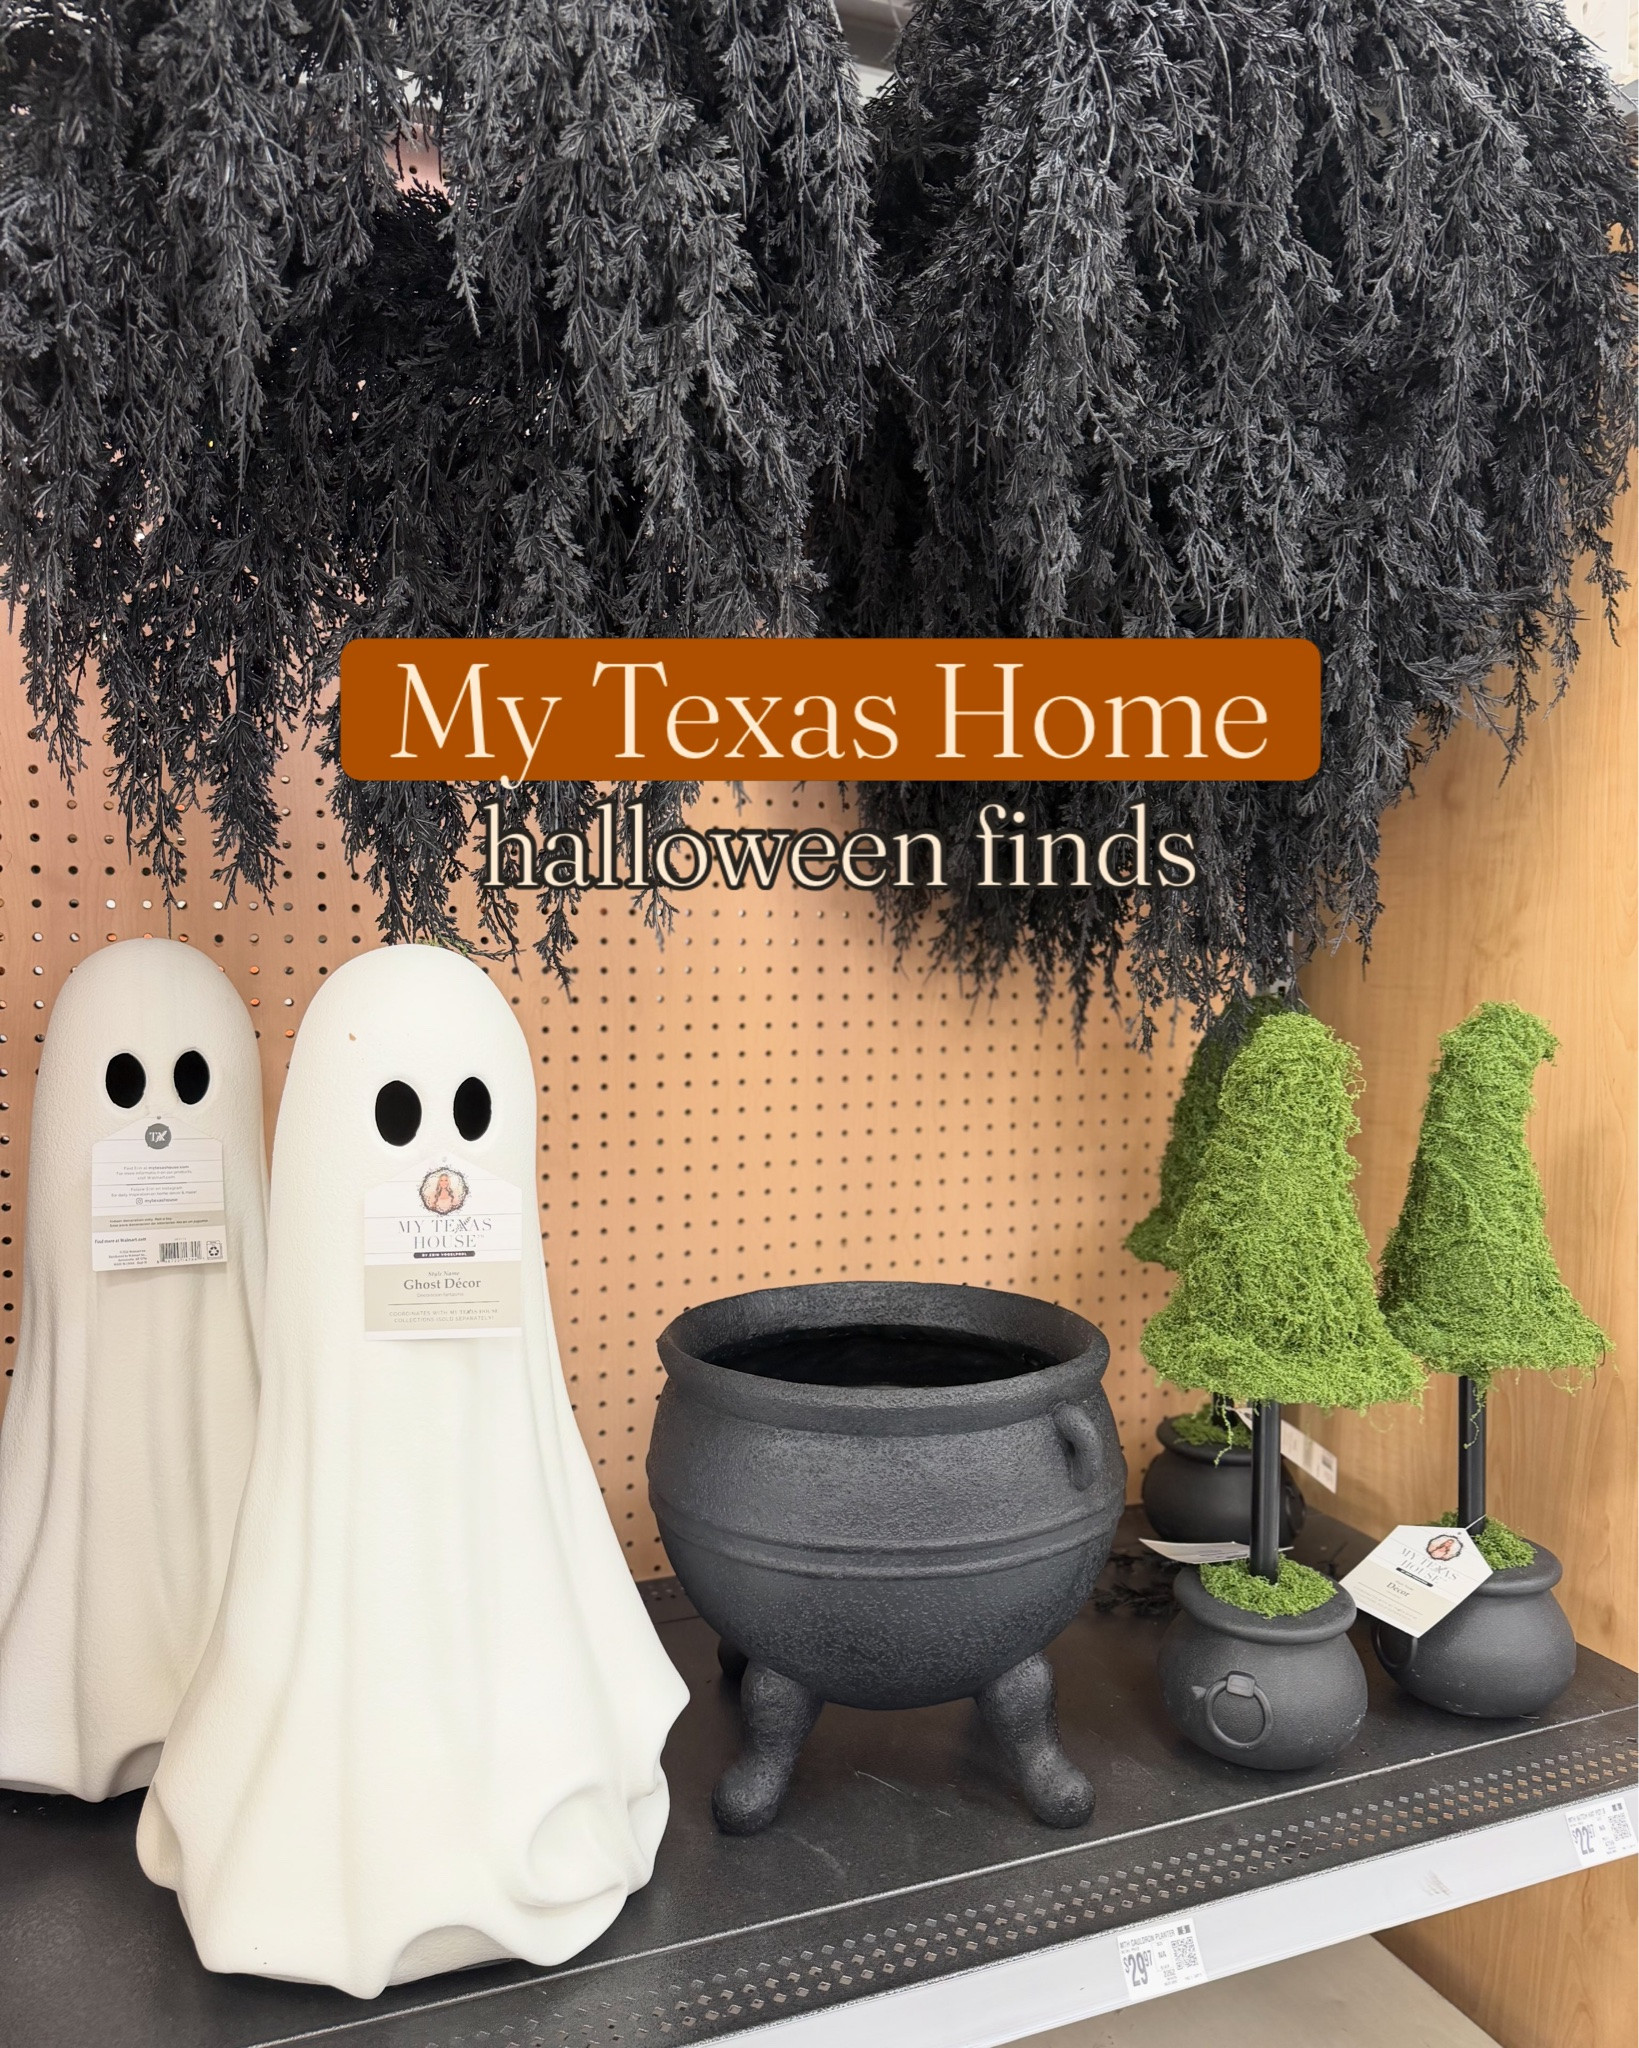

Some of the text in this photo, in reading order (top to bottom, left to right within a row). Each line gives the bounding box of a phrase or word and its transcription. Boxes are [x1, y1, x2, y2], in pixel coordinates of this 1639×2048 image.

[398, 1217, 492, 1233] MY TEXAS
[414, 1235, 477, 1249] HOUSE
[403, 1278, 482, 1290] Ghost Décor
[1400, 1547, 1417, 1560] MY
[1420, 1557, 1458, 1581] TEXAS
[1400, 1559, 1441, 1583] HOUSE
